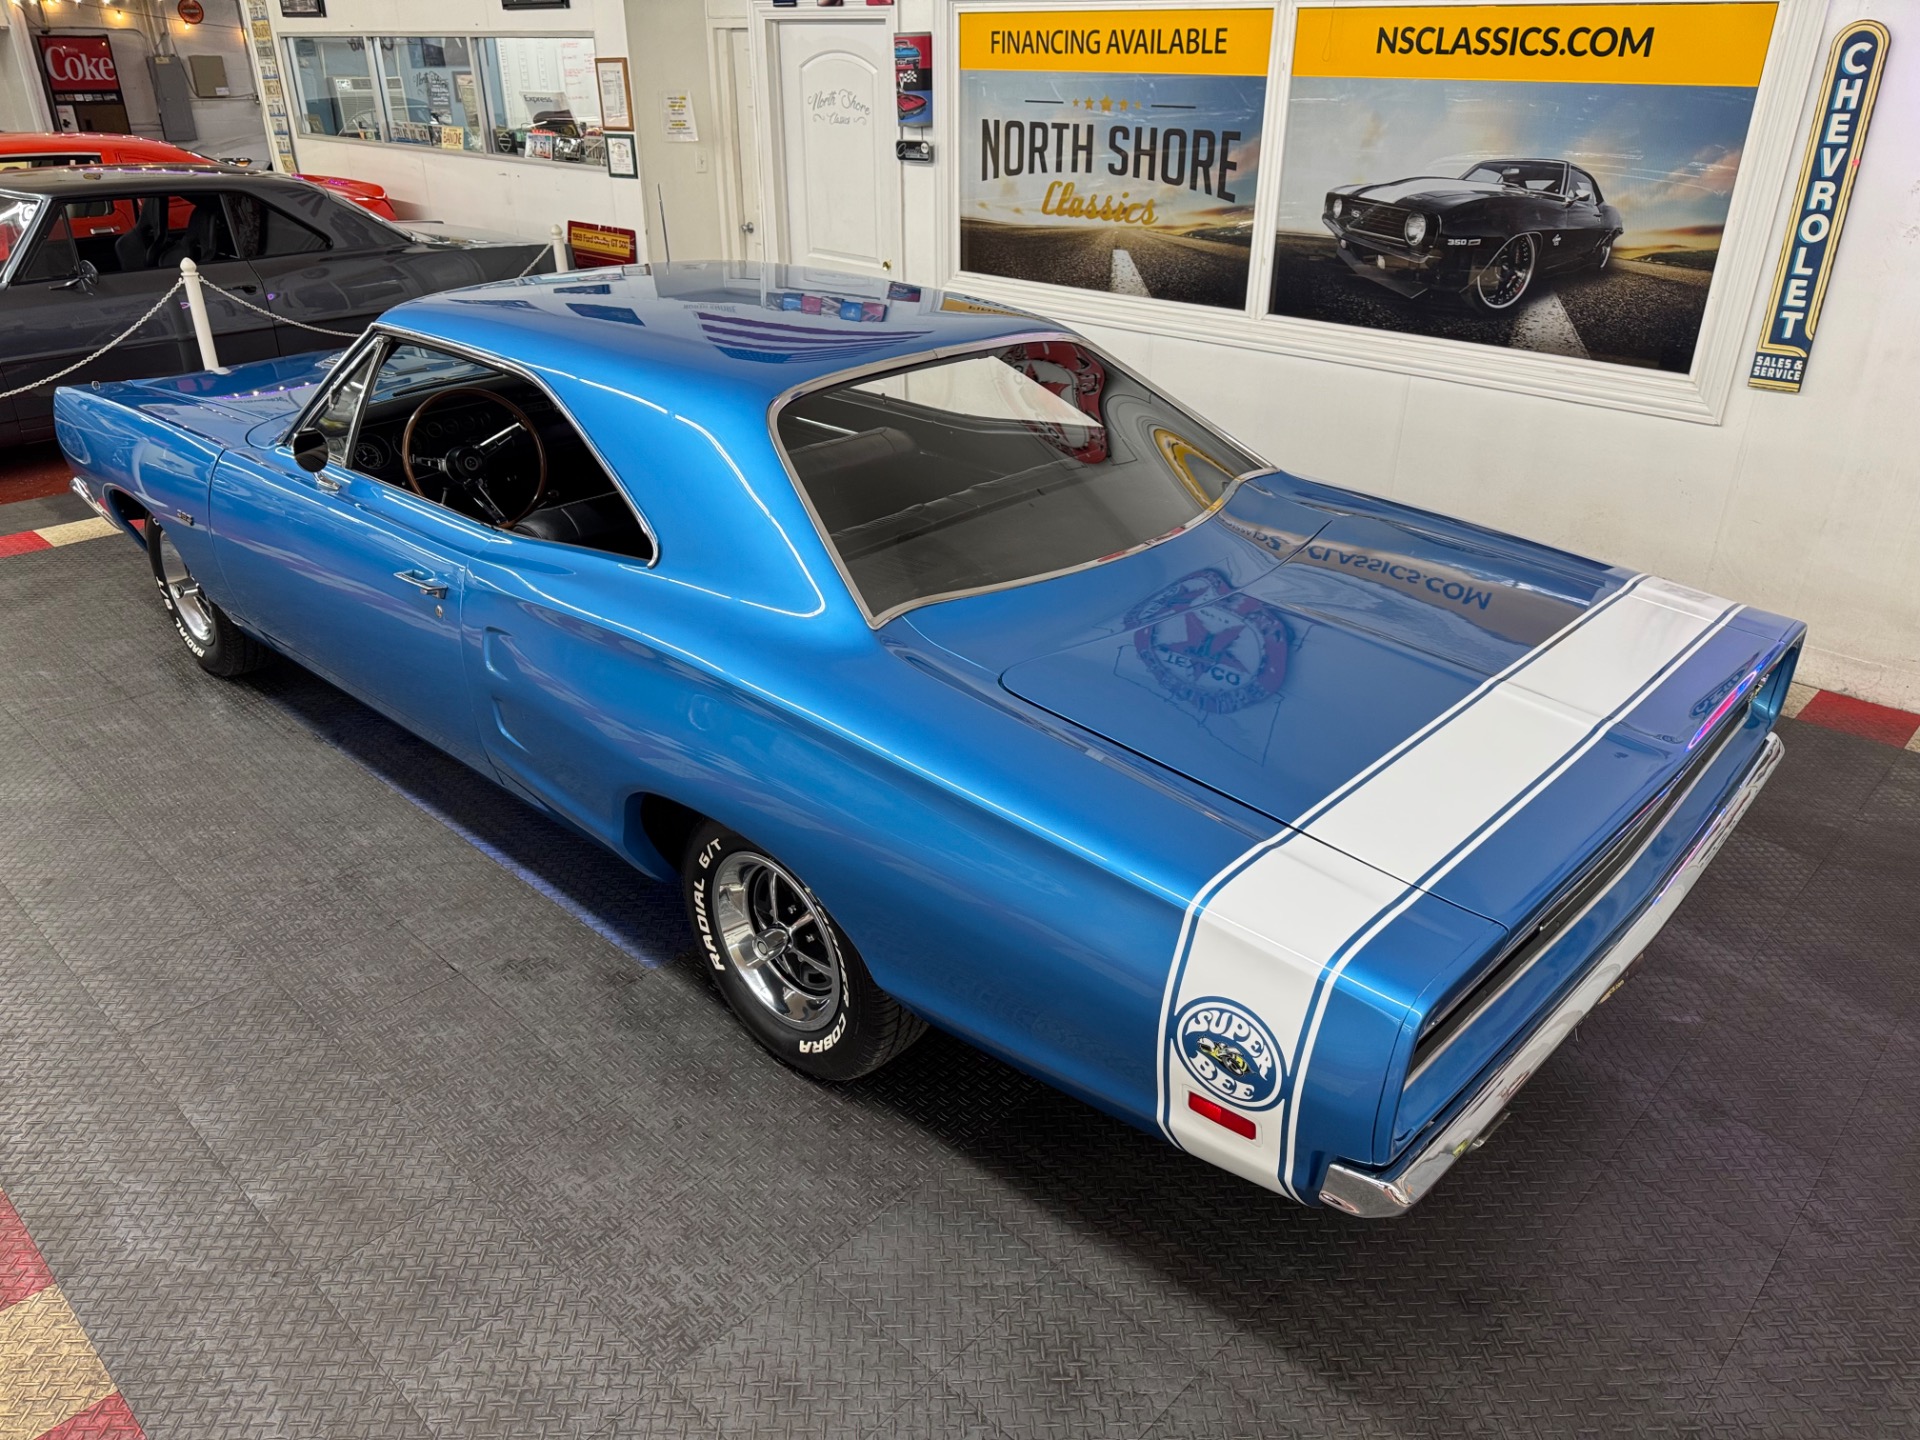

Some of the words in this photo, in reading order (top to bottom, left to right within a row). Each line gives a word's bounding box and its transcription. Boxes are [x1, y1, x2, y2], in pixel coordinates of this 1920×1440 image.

[990, 29, 1101, 55] FINANCING
[1105, 27, 1228, 55] AVAILABLE
[1375, 26, 1655, 58] NSCLASSICS.COM
[44, 46, 117, 82] Coke
[807, 90, 837, 111] North
[838, 88, 871, 116] Shore
[981, 118, 1094, 181] NORTH
[1107, 125, 1242, 203] SHORE
[1041, 180, 1159, 225] Classics
[1780, 41, 1876, 340] CHEVROLET
[1447, 238, 1467, 246] 350
[1752, 366, 1802, 381] SERVICE
[1755, 355, 1793, 369] SALES
[1793, 360, 1803, 370] &
[698, 837, 723, 870] G/T
[693, 877, 727, 972] RADIAL
[799, 1012, 847, 1054] COBRA
[1185, 1009, 1273, 1081] SUPER
[1189, 1050, 1255, 1100] BEE
